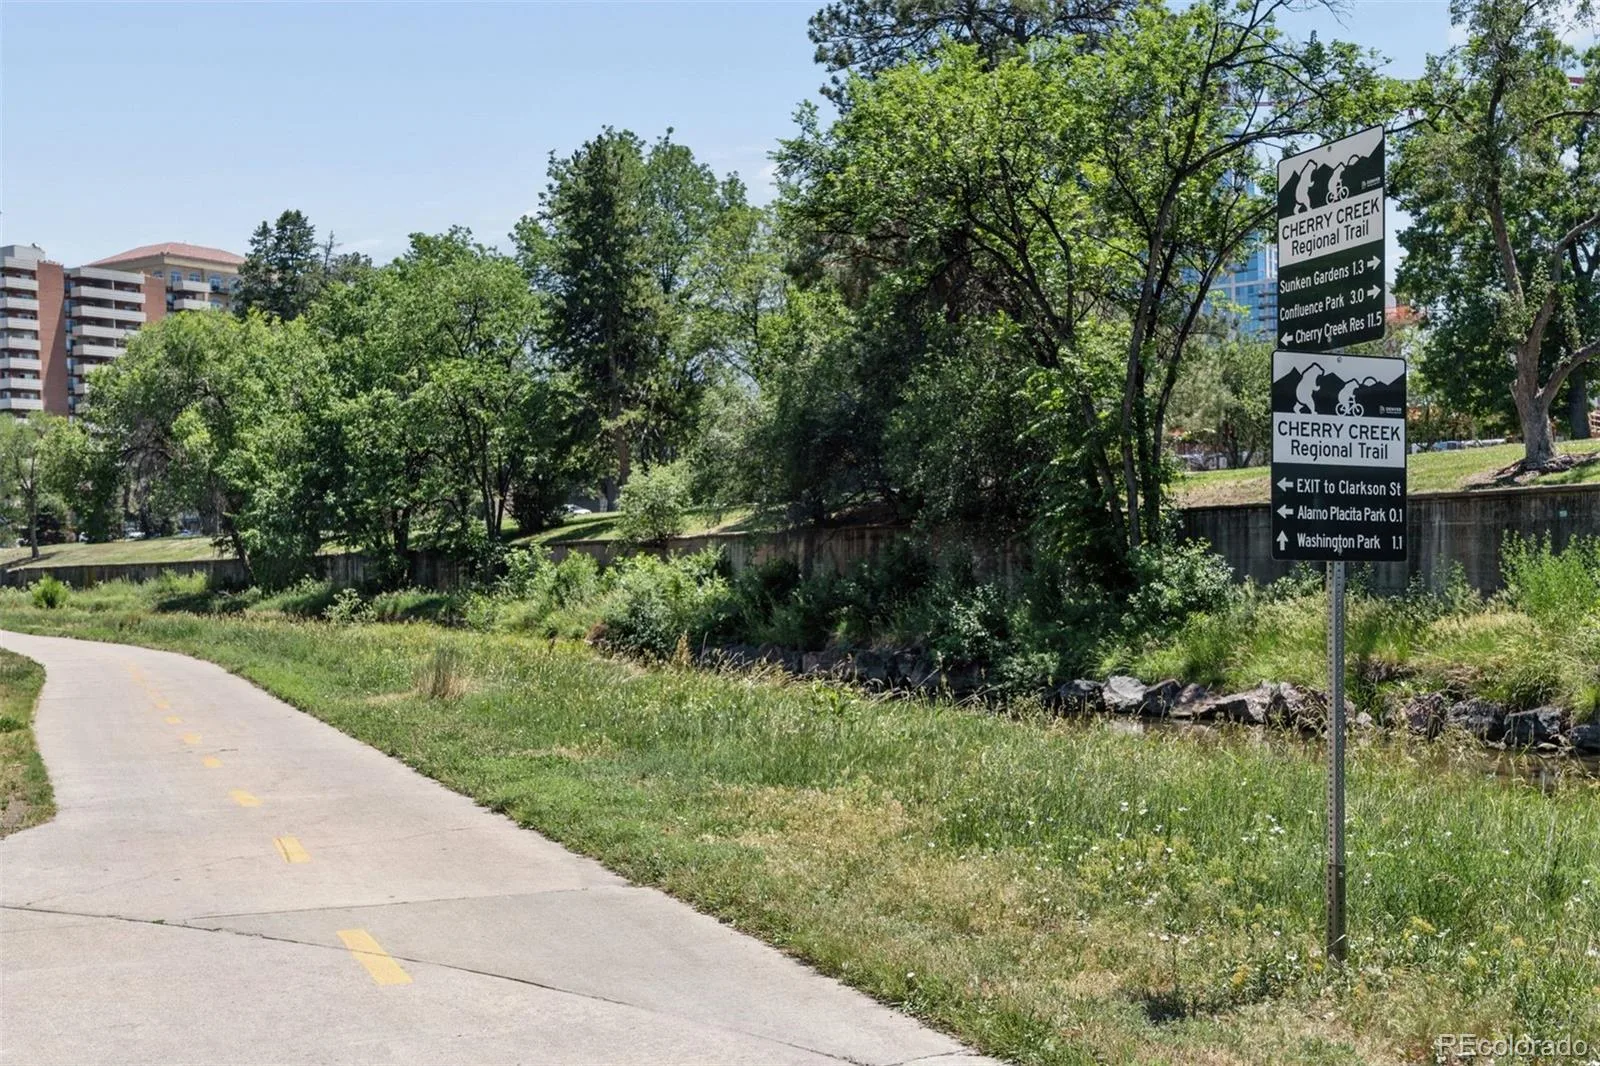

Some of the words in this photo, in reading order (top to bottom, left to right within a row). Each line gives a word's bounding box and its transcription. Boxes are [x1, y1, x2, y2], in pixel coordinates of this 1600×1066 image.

[1282, 212, 1333, 240] CHERRY
[1336, 197, 1380, 224] CREEK
[1291, 229, 1340, 257] Regional
[1344, 220, 1369, 241] Trail
[1280, 274, 1312, 294] Sunken
[1313, 265, 1349, 285] Gardens
[1352, 260, 1364, 276] 1.3
[1280, 298, 1323, 321] Confluence
[1325, 294, 1344, 312] Park
[1350, 288, 1364, 305] 3.0
[1295, 326, 1322, 344] Cherry
[1324, 319, 1348, 338] Creek
[1349, 316, 1364, 332] Res
[1367, 311, 1382, 328] 11.5
[1278, 421, 1344, 439] CHERRY
[1348, 424, 1400, 441] CREEK
[1291, 439, 1352, 461] Regional
[1358, 442, 1388, 460] Trail
[1297, 478, 1320, 493] EXIT
[1324, 480, 1335, 494] to
[1338, 480, 1386, 496] Clarkson
[1389, 482, 1401, 496] St
[1297, 505, 1328, 521] Alamo
[1330, 506, 1362, 522] Placita
[1364, 507, 1386, 522] Park
[1389, 508, 1402, 523] 0.1
[1297, 533, 1355, 552] Washington
[1357, 535, 1381, 550] Park
[1392, 536, 1402, 550] 1.1
